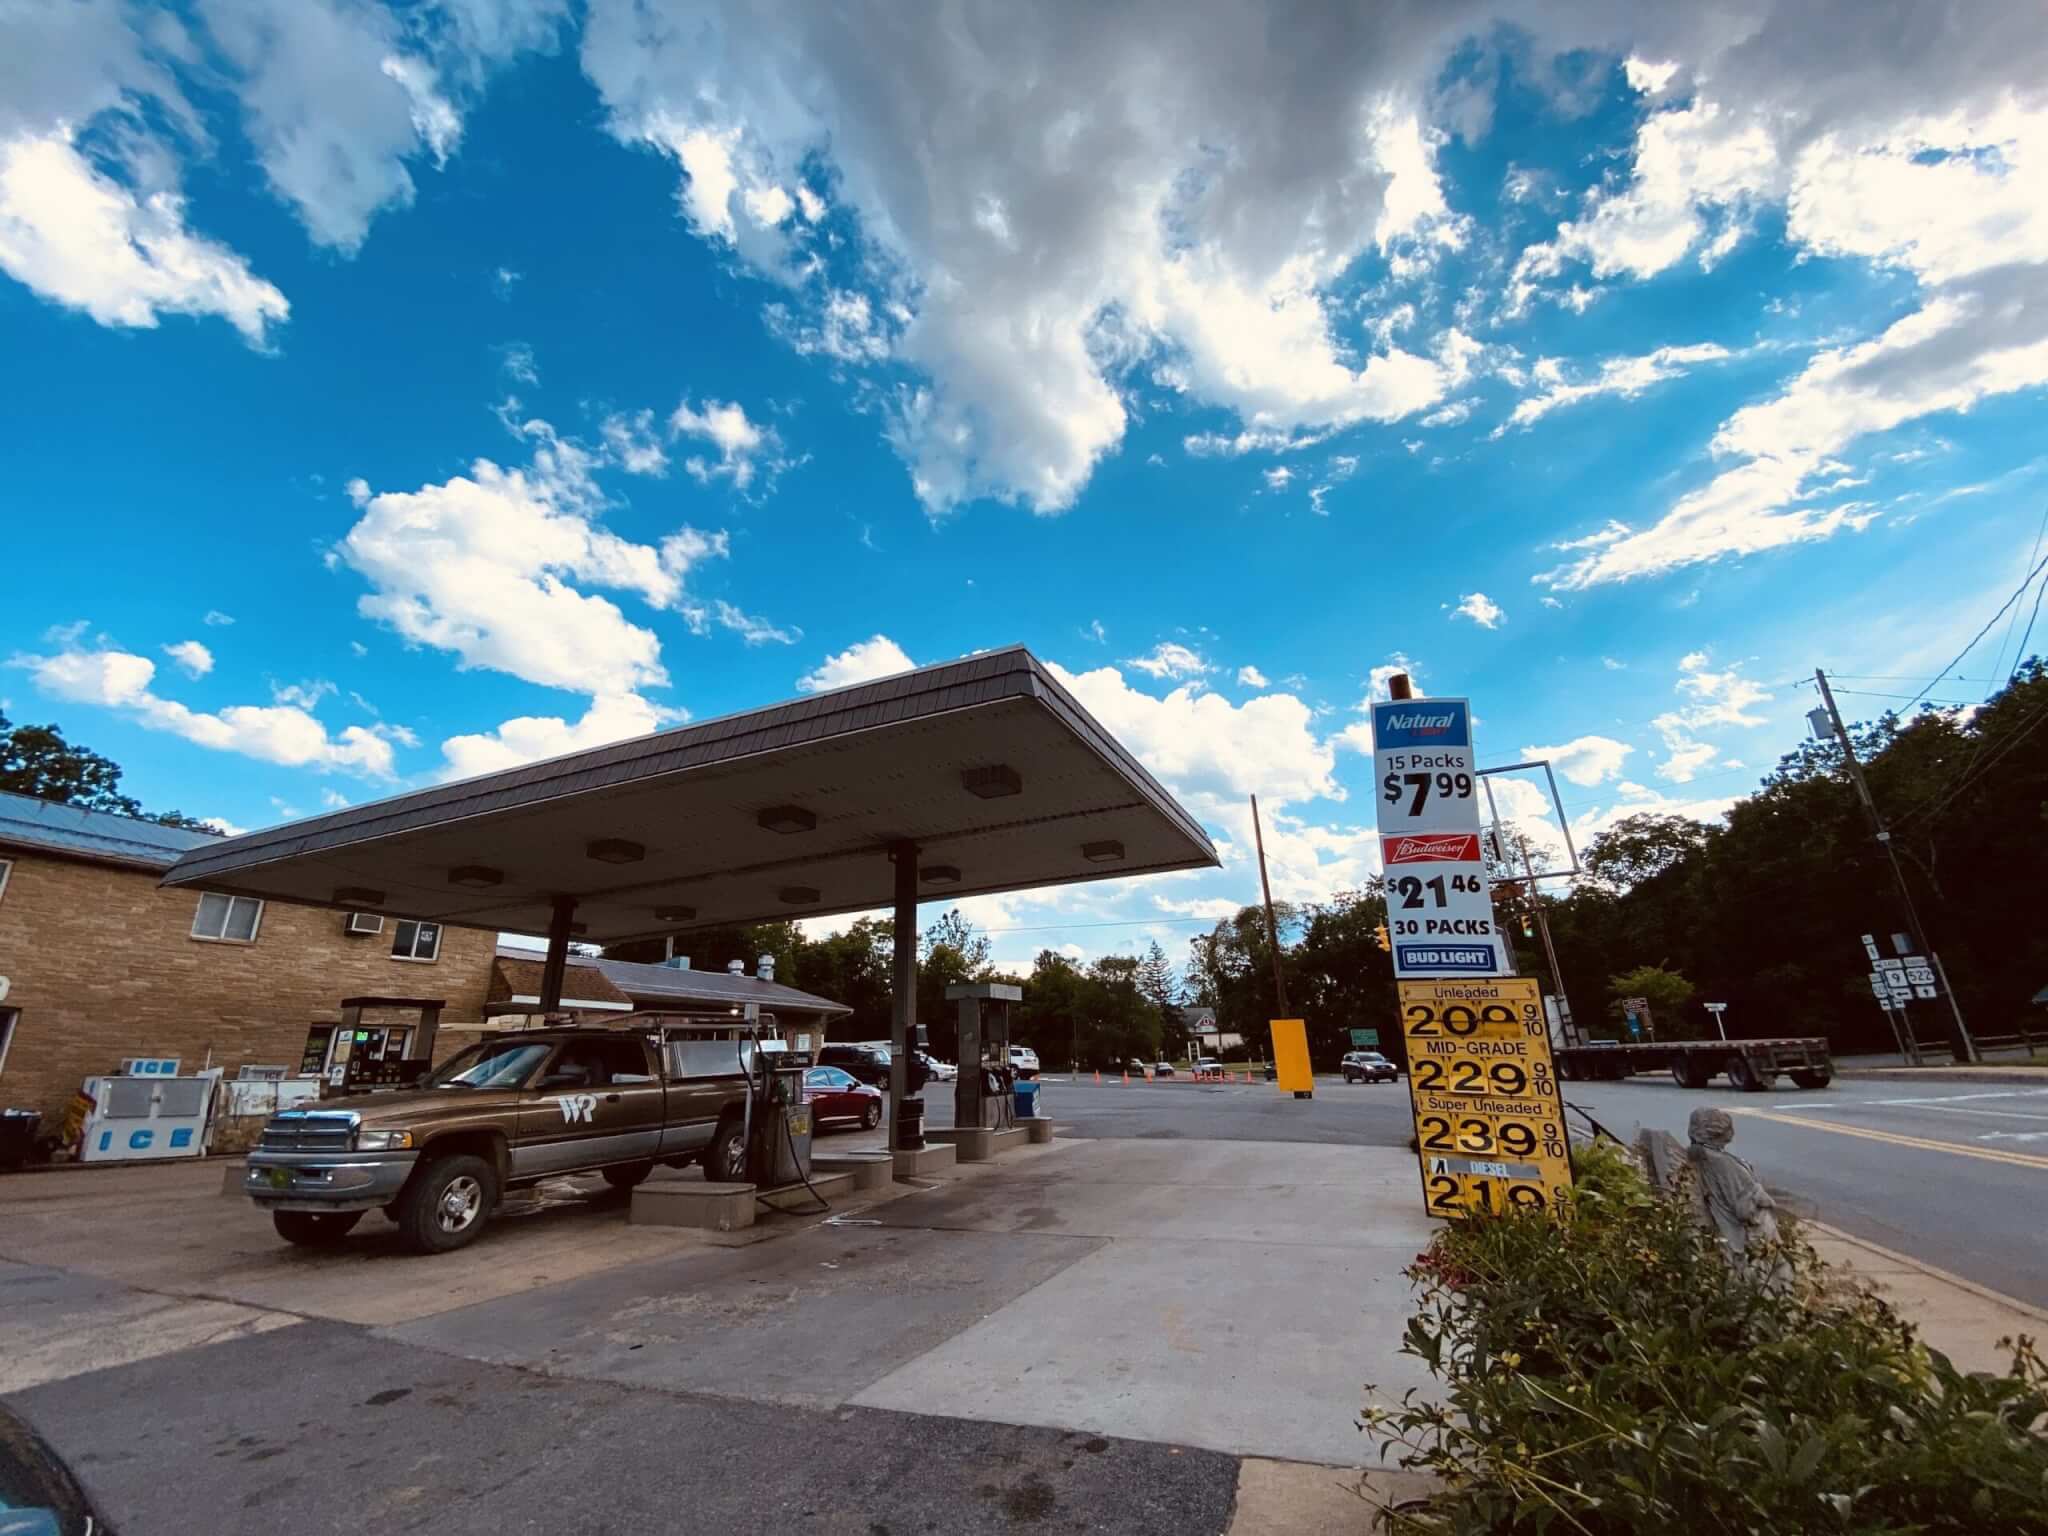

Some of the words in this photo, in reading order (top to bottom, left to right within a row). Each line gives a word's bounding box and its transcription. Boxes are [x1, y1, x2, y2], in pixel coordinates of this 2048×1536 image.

[1385, 711, 1456, 731] Natural
[1386, 755, 1405, 770] 15
[1412, 754, 1464, 769] Packs
[1397, 842, 1464, 856] Budweiser
[1395, 920, 1418, 935] 30
[1426, 919, 1490, 936] PACKS
[1406, 951, 1440, 964] BUD
[1441, 951, 1486, 964] LIGHT
[1891, 973, 1900, 983] 9
[1908, 969, 1933, 982] 522
[1434, 987, 1499, 999] Unleaded
[1427, 1041, 1528, 1056] MID-GRADE
[134, 1061, 177, 1074] ICE
[1414, 1059, 1526, 1095] 229
[1430, 1098, 1468, 1112] Super
[1473, 1100, 1543, 1114] Unleaded
[98, 1127, 194, 1152] ICE
[1422, 1117, 1537, 1156] 239
[1470, 1160, 1511, 1178] DIESEL
